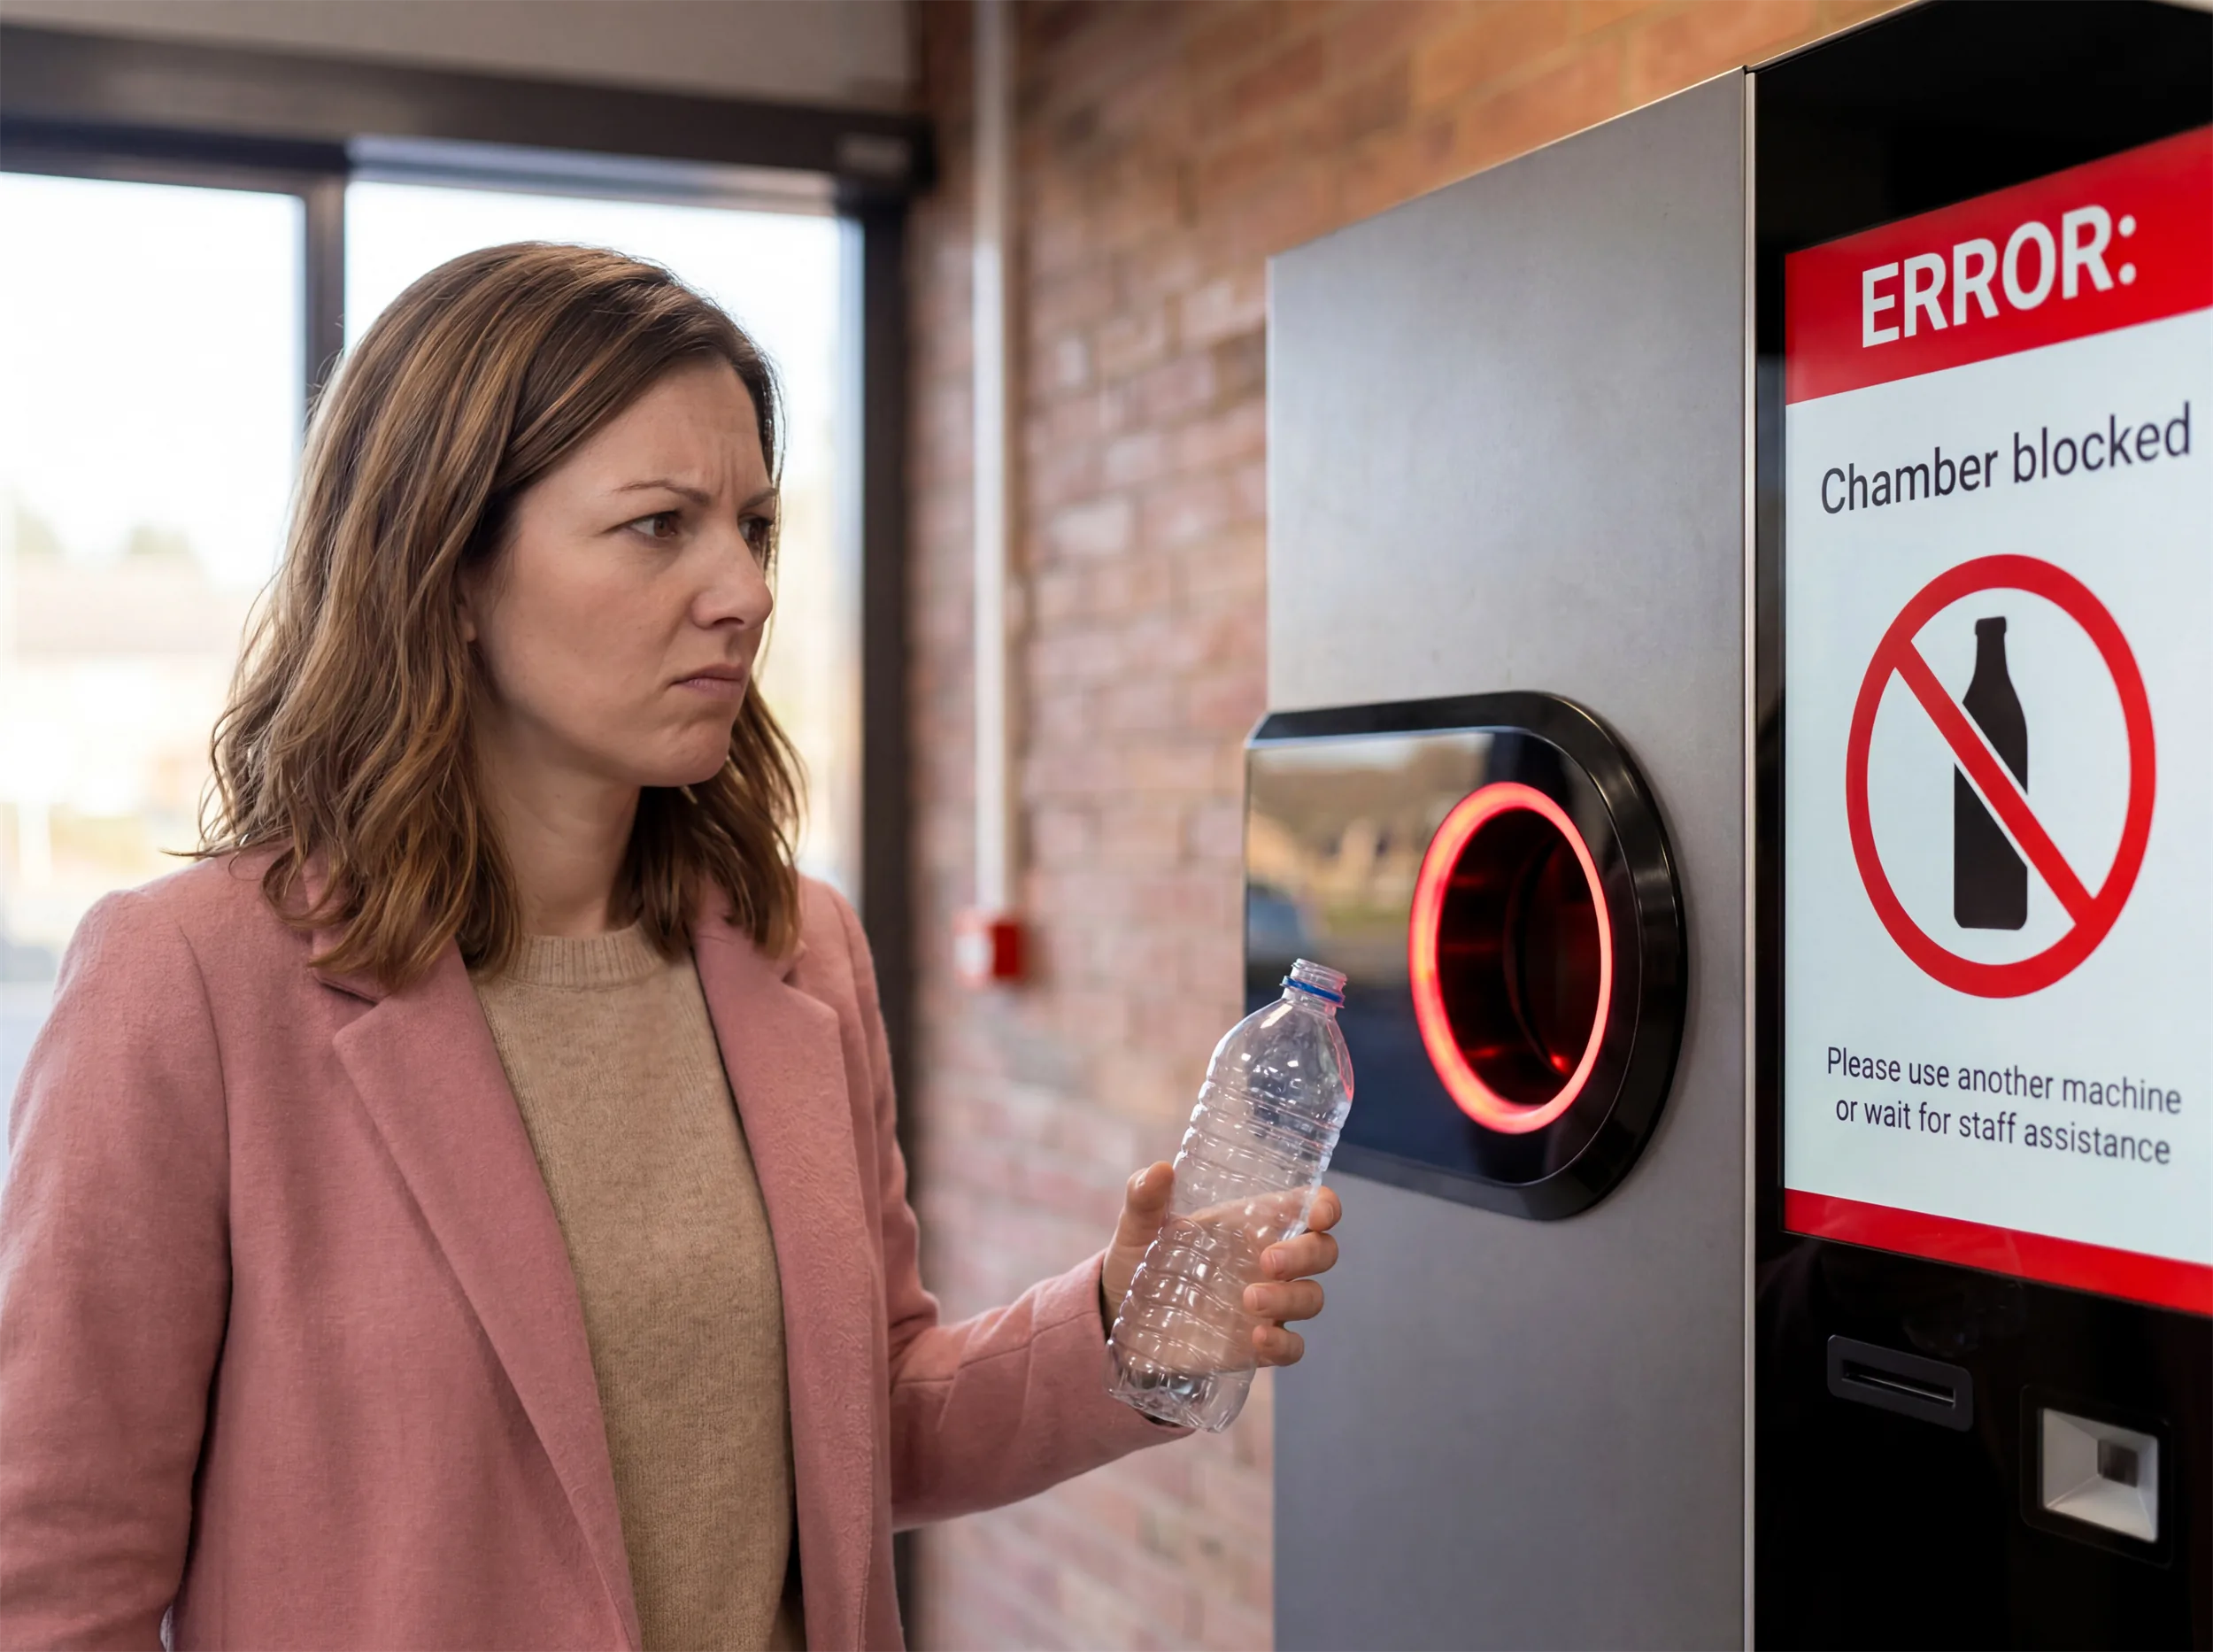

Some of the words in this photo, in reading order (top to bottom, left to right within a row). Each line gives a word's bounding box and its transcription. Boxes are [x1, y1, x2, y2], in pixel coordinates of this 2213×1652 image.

[1862, 205, 2138, 348] ERROR:
[1821, 445, 1999, 514] Chamber
[2013, 401, 2191, 484] blocked
[1827, 1046, 1901, 1084] Please
[1908, 1061, 1950, 1088] use
[1957, 1064, 2055, 1100] another
[2063, 1077, 2182, 1115] machine
[1836, 1099, 1859, 1123] or
[1863, 1100, 1911, 1131] wait
[1918, 1100, 1952, 1135] for
[1959, 1111, 2017, 1144] staff
[2024, 1122, 2171, 1165] assistance
